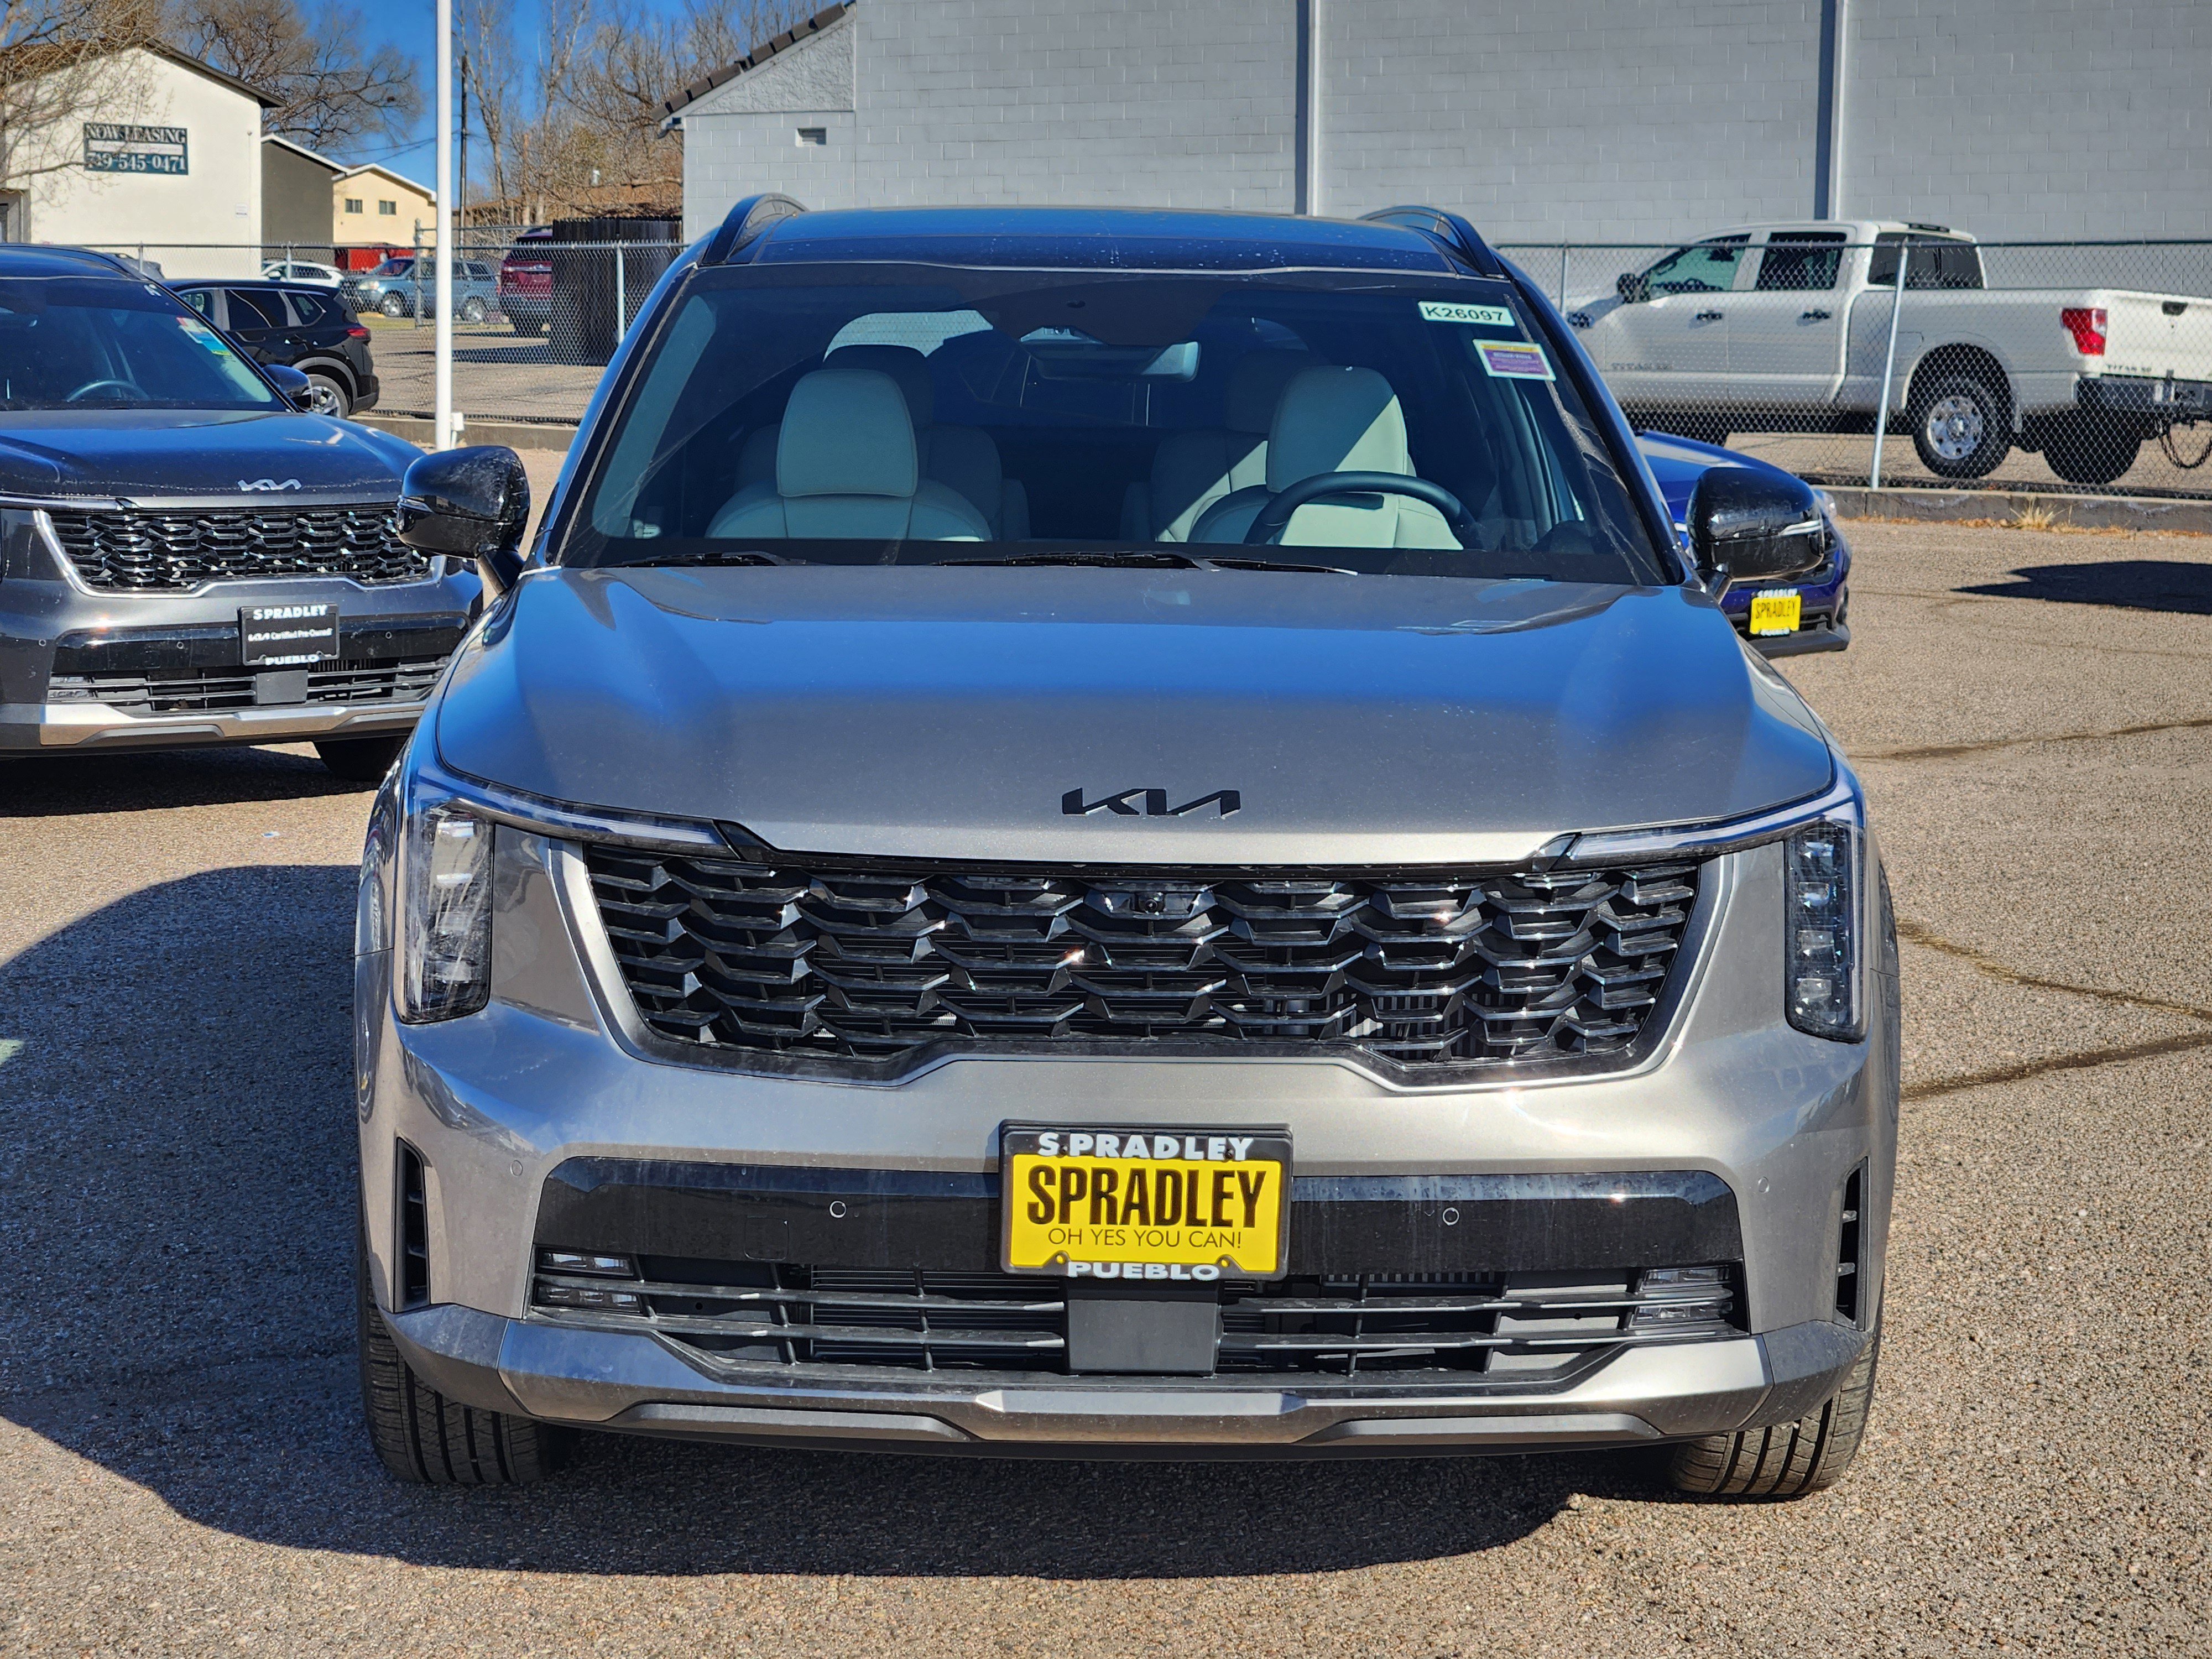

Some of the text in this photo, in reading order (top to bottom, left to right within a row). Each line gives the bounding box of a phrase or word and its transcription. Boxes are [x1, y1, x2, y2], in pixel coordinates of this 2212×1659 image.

[86, 124, 186, 144] NOW LEASING
[1425, 306, 1503, 321] K26097
[253, 604, 328, 620] SPRADLEY
[1755, 600, 1796, 619] SPRADLEY
[265, 654, 320, 666] PUEBLO
[1062, 787, 1241, 819] KIA
[1038, 1131, 1255, 1161] SPRADLEY
[1027, 1164, 1267, 1228] SPRADLEY
[1048, 1228, 1241, 1249] OH YES YOU CAN!
[1067, 1261, 1220, 1280] PUEBLO
